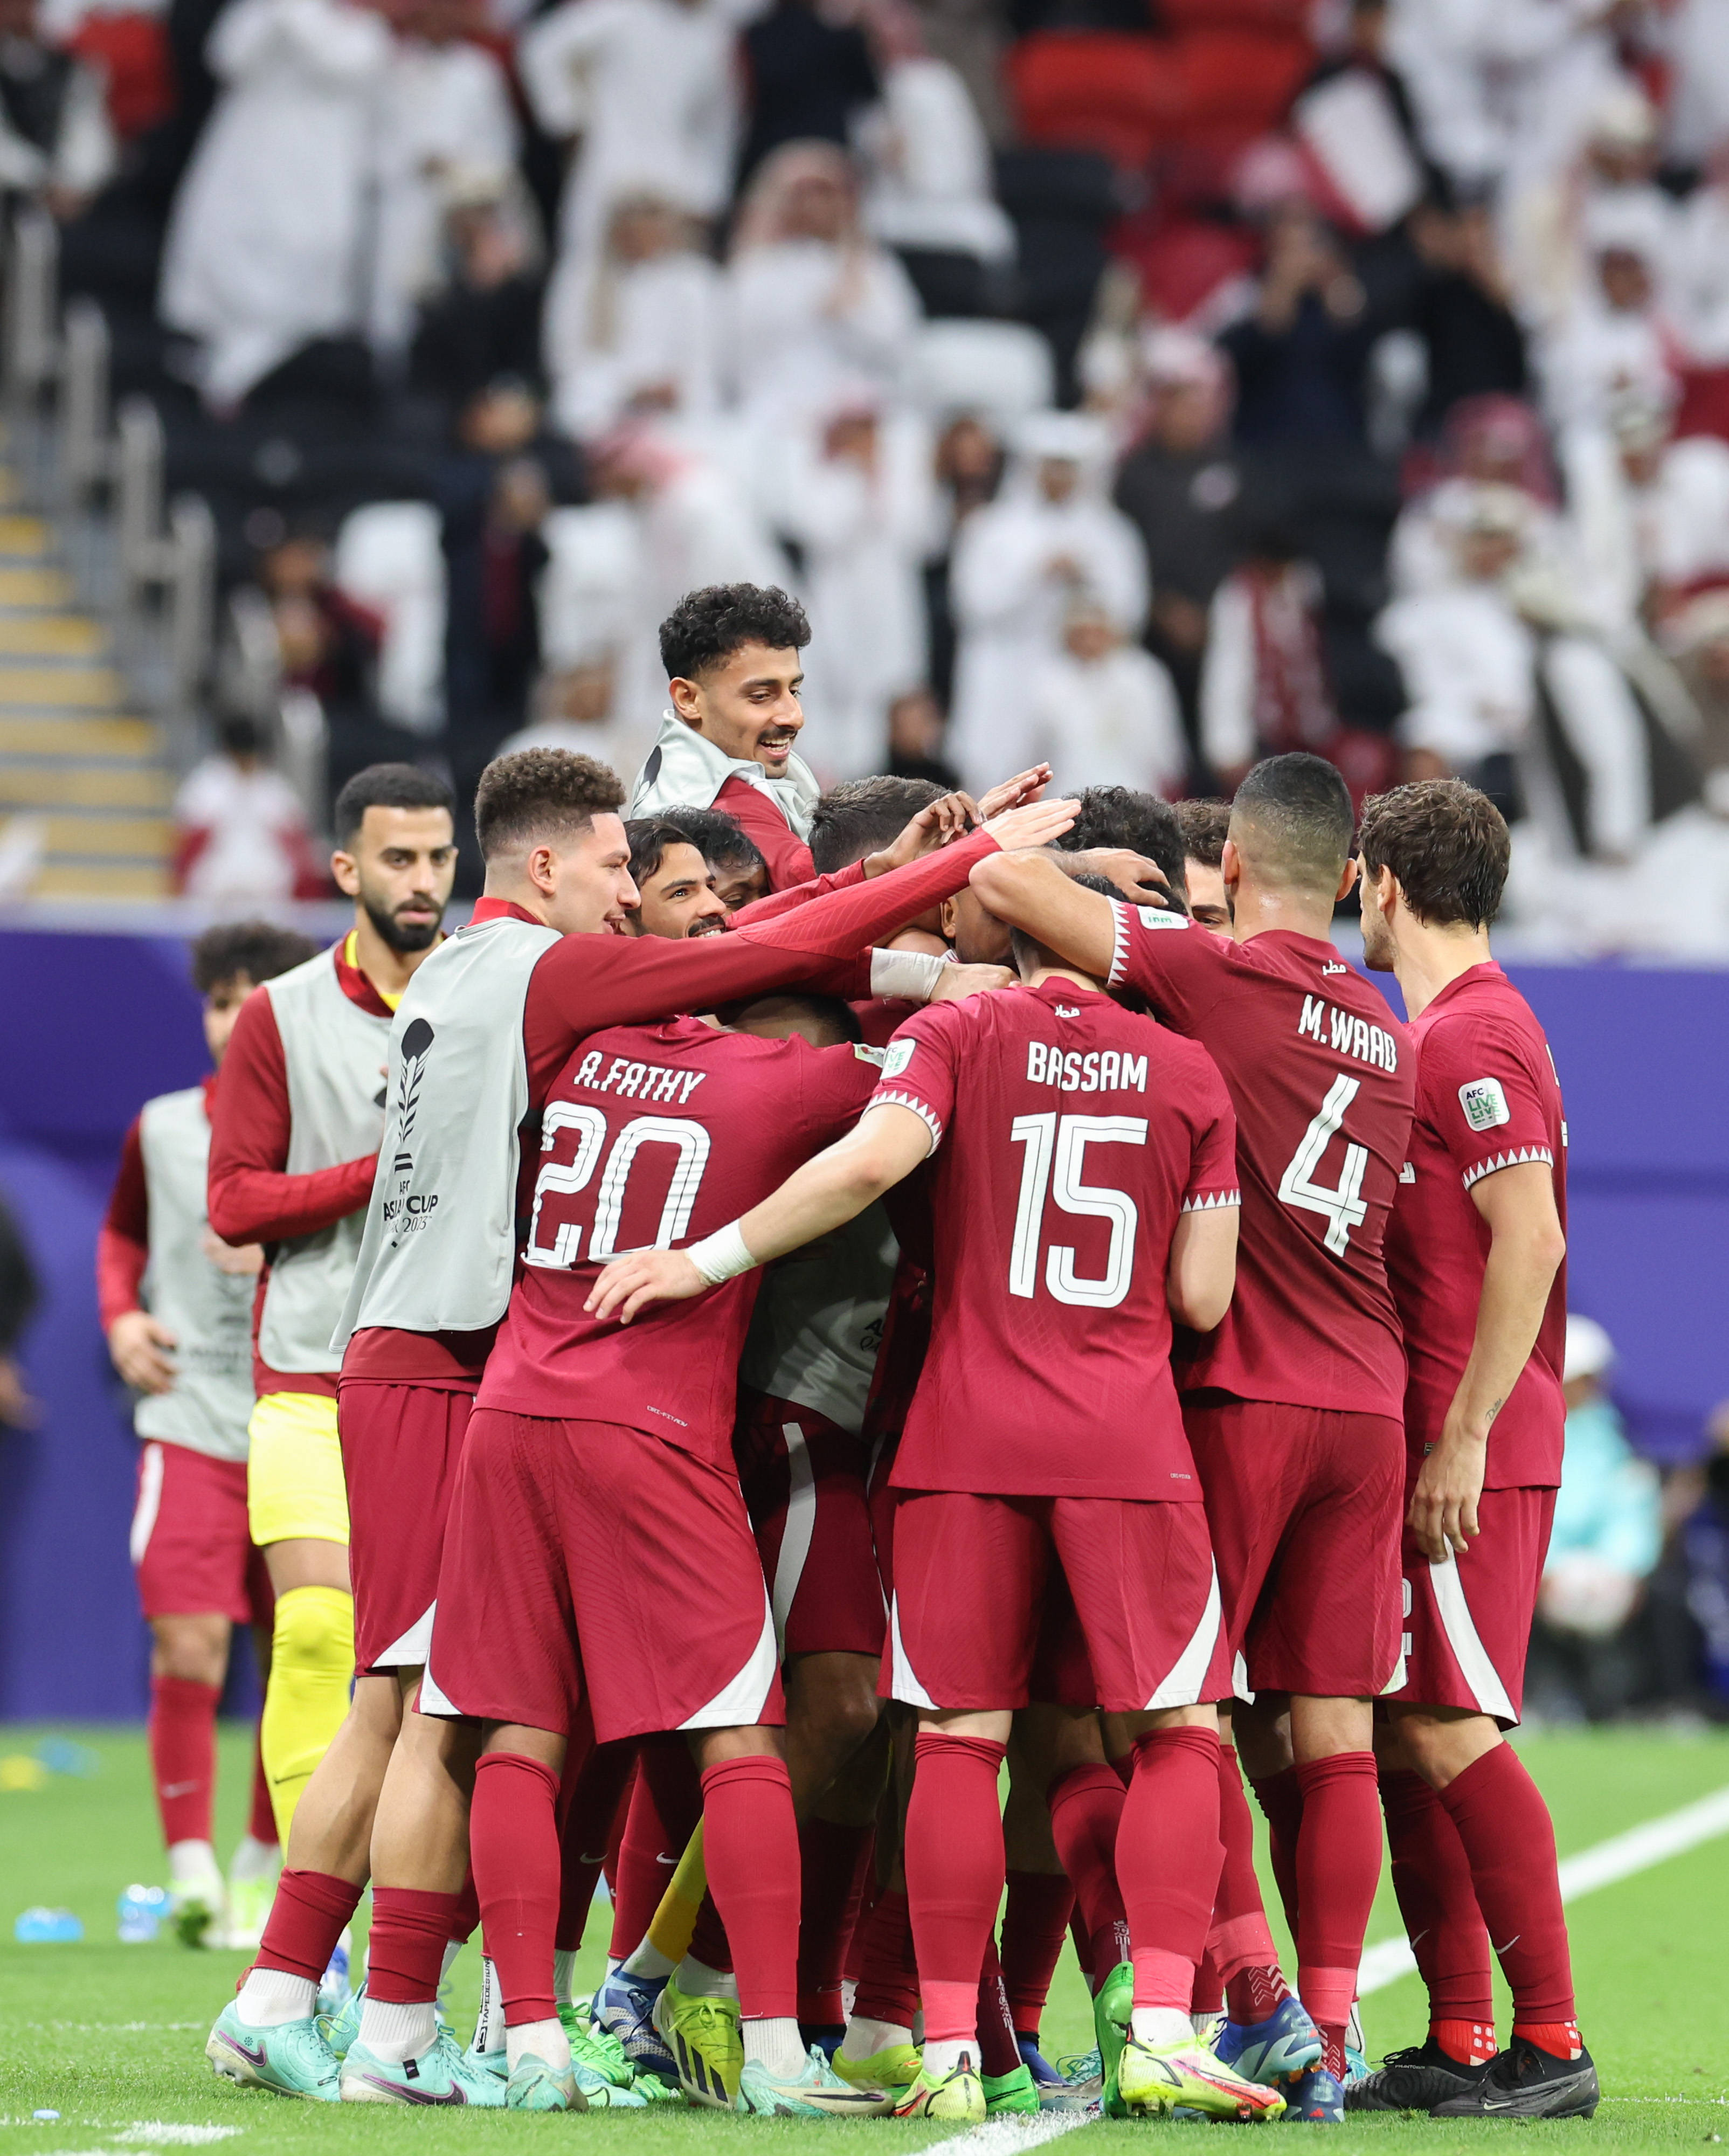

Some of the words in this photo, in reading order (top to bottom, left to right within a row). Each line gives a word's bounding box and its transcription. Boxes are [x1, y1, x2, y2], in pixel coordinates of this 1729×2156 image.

[1298, 994, 1397, 1073] M.WAAD
[573, 1051, 707, 1104] A.FATHY
[1027, 1041, 1148, 1093] BASSAM
[1466, 1087, 1484, 1100] AFC
[1467, 1094, 1498, 1112] LIVE
[521, 1100, 711, 1270] 20
[1277, 1073, 1368, 1257] 4
[406, 1194, 438, 1214] CUP
[1009, 1111, 1149, 1308] 15
